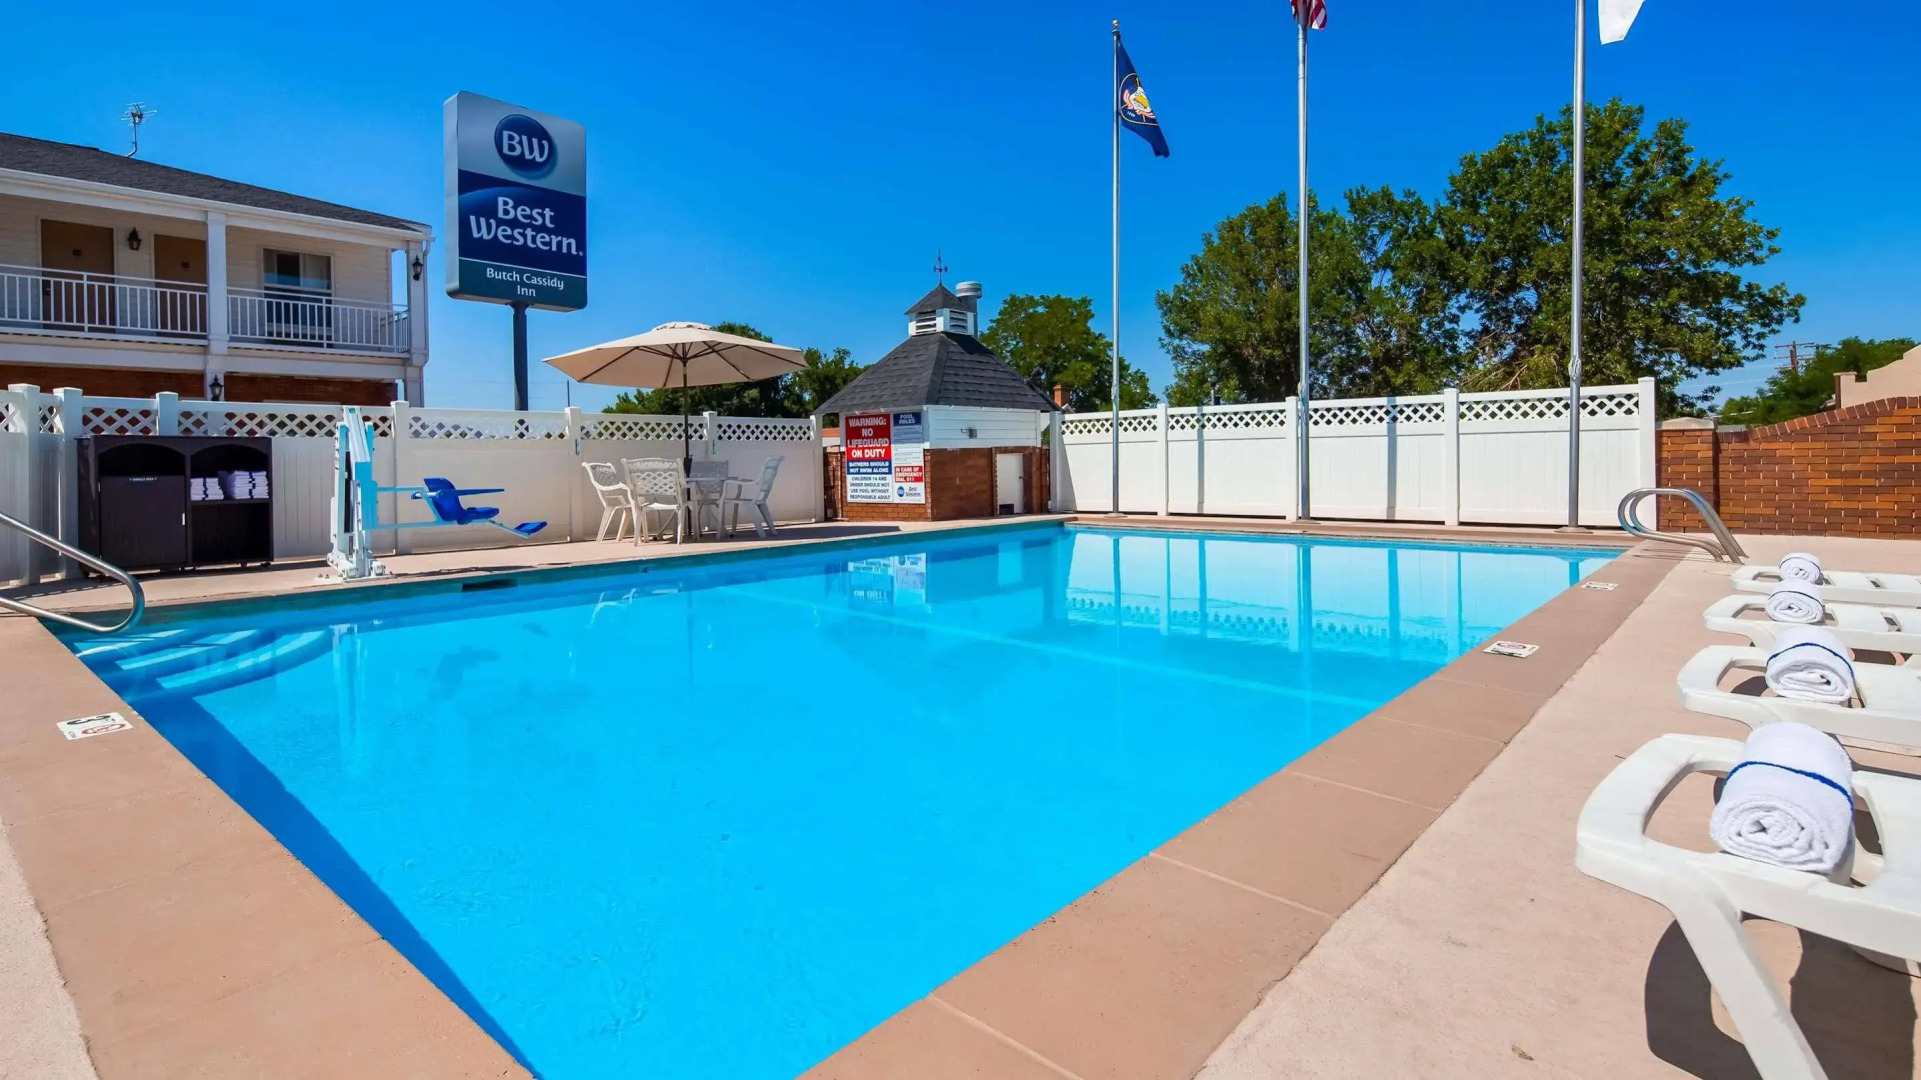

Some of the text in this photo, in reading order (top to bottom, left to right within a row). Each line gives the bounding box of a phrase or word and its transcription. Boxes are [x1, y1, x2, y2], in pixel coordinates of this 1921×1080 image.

[502, 130, 549, 163] BW
[497, 196, 555, 228] Best
[486, 267, 564, 290] Butch Cassidy
[517, 285, 536, 297] Inn
[848, 416, 886, 428] WARNING:
[862, 428, 874, 437] NO
[847, 438, 890, 448] LIFEGUARD
[852, 449, 862, 458] ON
[864, 448, 886, 458] DUTY
